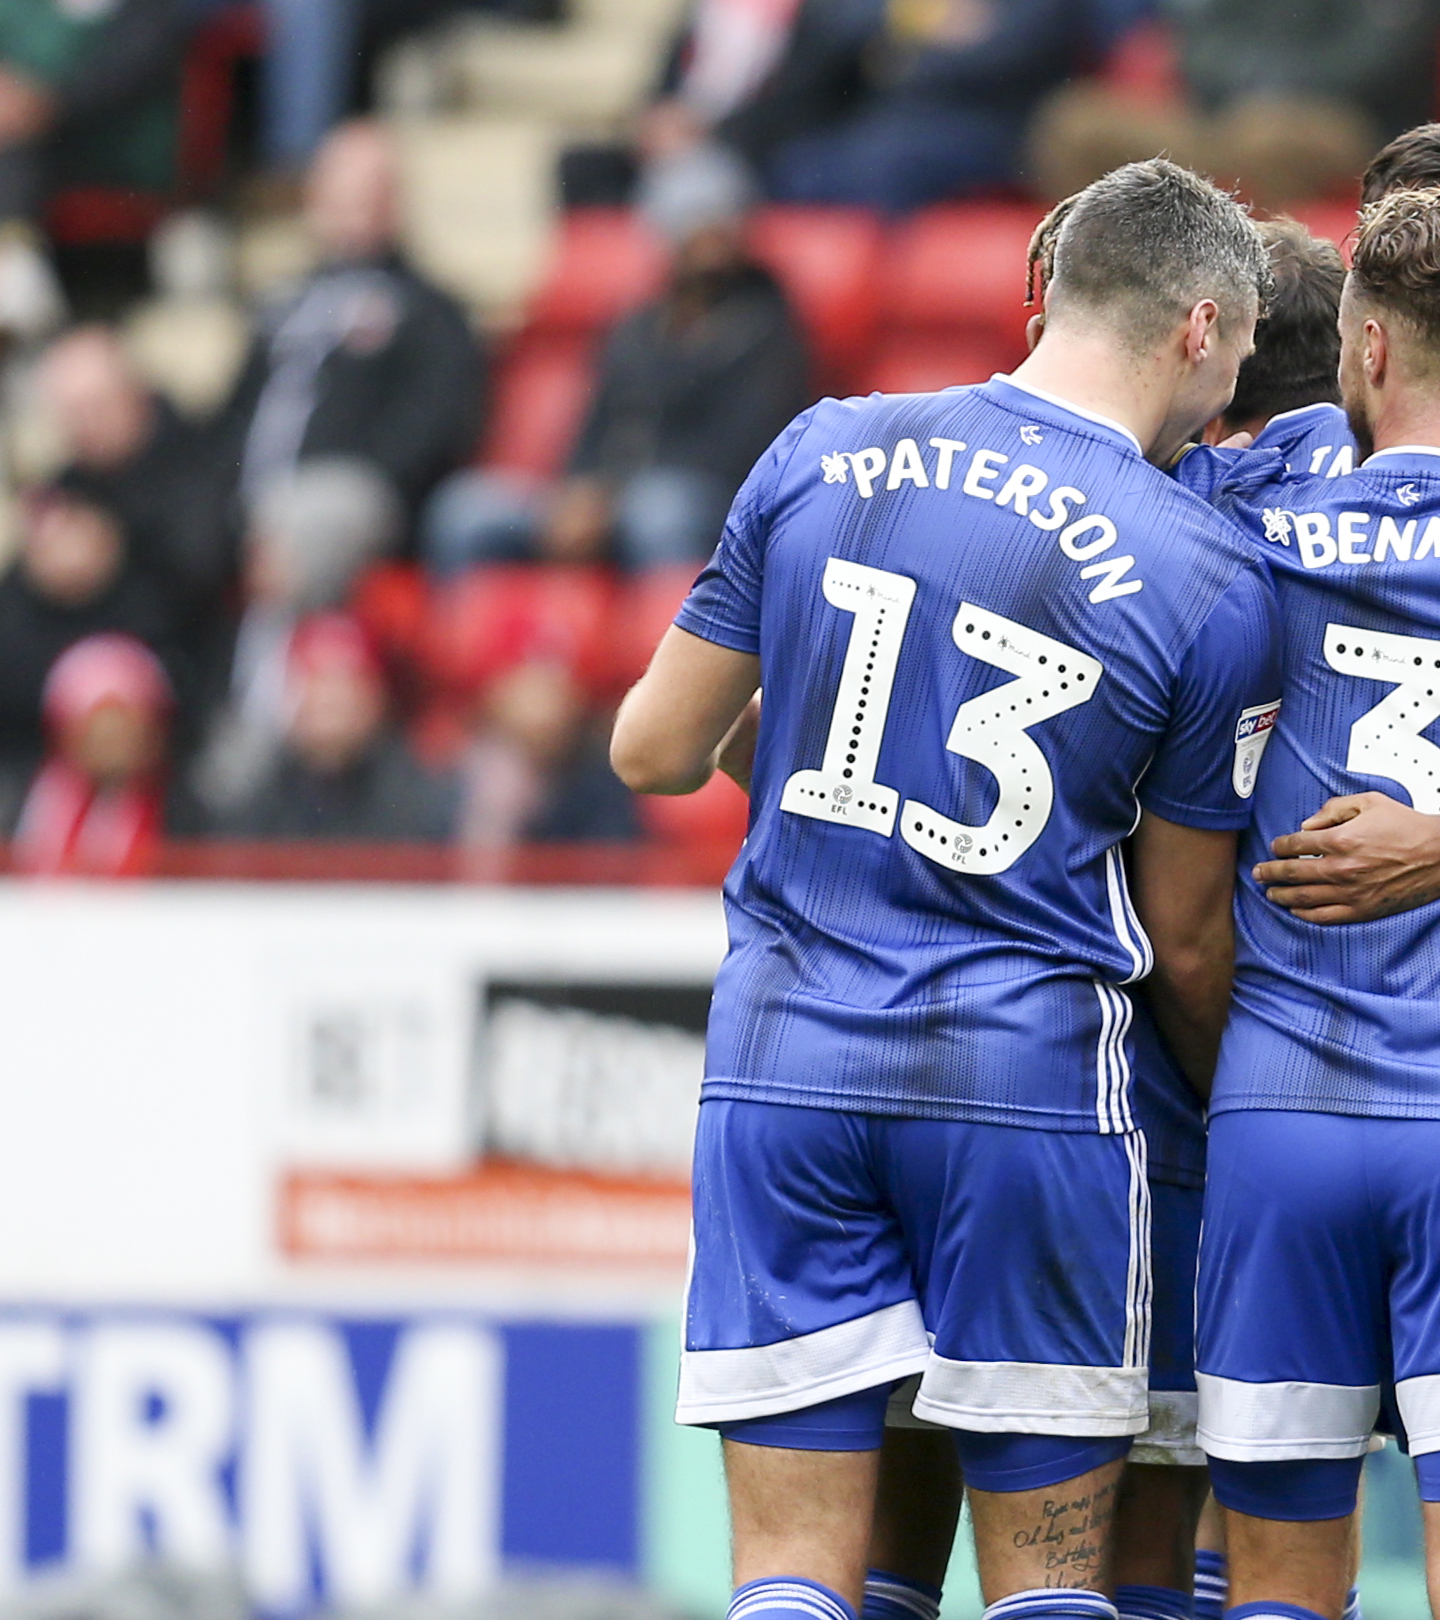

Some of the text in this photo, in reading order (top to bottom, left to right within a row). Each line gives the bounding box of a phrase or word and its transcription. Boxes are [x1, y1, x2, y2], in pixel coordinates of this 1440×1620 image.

[852, 437, 1143, 605] PATERSON
[780, 557, 1104, 876] 13
[1238, 711, 1277, 737] sky bet
[831, 804, 848, 816] EFL
[951, 852, 967, 866] EFL
